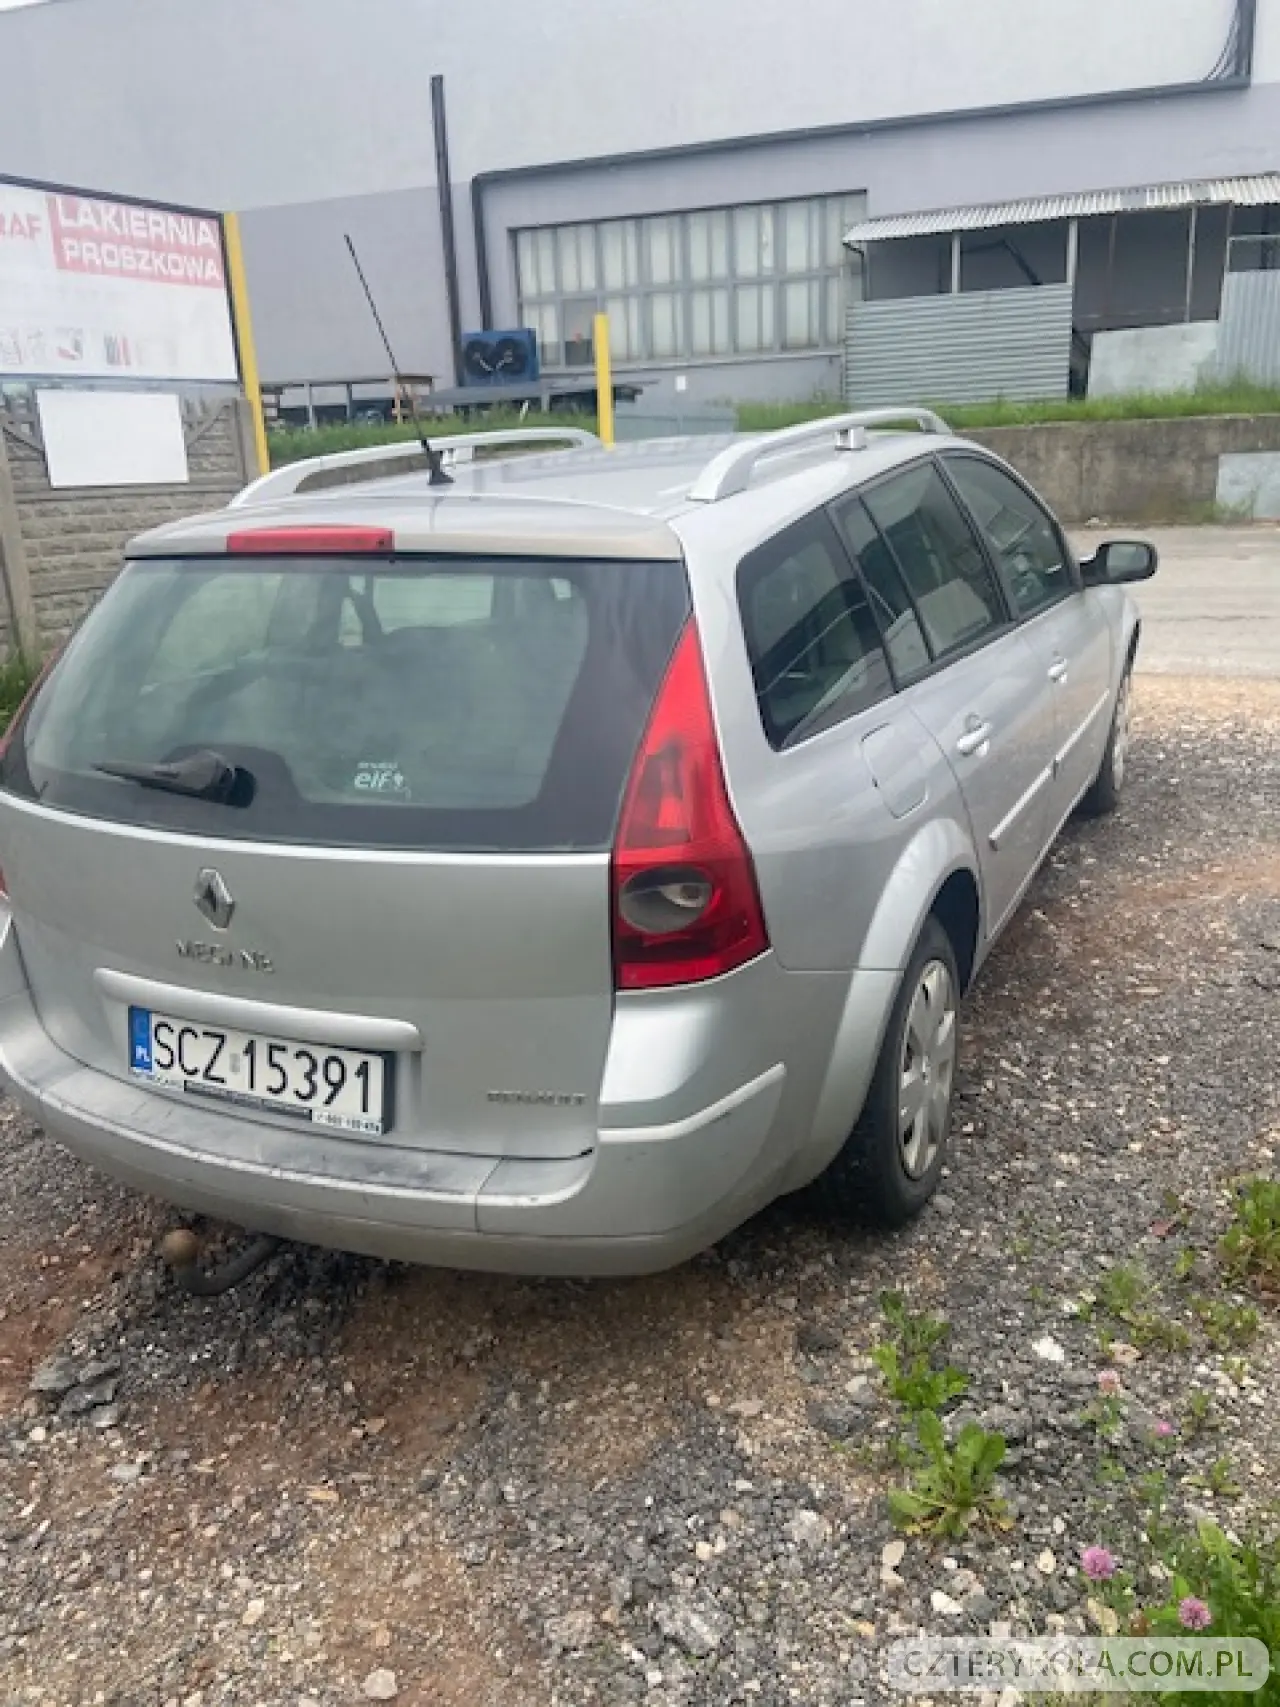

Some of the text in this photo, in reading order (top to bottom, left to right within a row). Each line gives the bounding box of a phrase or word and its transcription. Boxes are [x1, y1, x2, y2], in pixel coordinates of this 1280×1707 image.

[56, 196, 218, 249] LAKIERNIA
[61, 237, 222, 281] PROSZKOWA
[153, 1021, 227, 1084] SCZ
[241, 1038, 370, 1113] 15391
